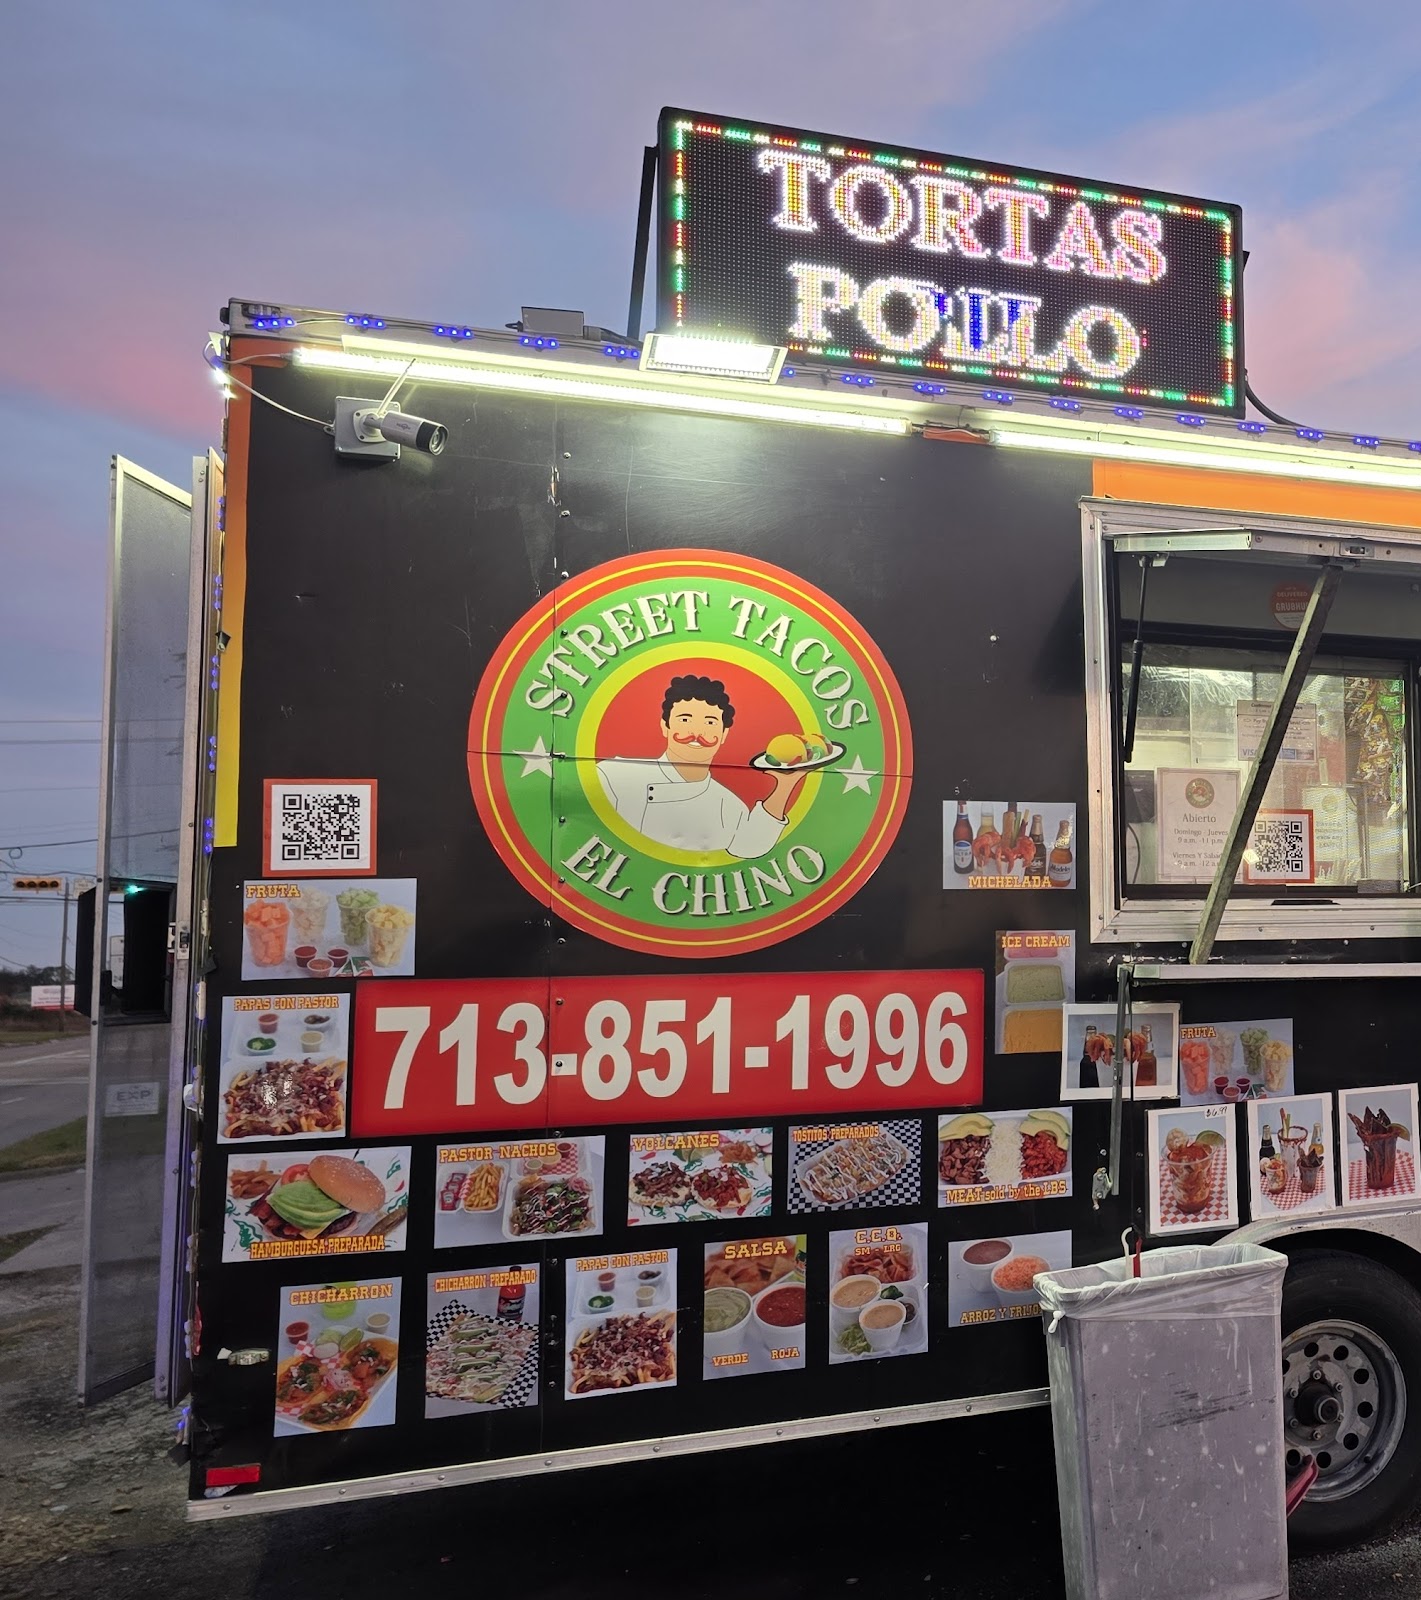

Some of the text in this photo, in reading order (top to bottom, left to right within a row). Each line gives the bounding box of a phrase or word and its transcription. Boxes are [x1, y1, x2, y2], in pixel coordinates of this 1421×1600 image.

[756, 147, 1167, 285] TORTAS
[1276, 602, 1308, 611] GRUBHU
[525, 590, 870, 730] STREET TACOS
[1183, 813, 1216, 822] Abierto
[560, 834, 826, 916] EL CHINO
[968, 876, 1052, 888] MICHELADA
[246, 885, 300, 898] FRUTA
[1002, 936, 1070, 948] ICE CREAM
[234, 996, 338, 1011] PAPAS CON PASTOR
[1181, 1027, 1216, 1039] FRUTA
[375, 991, 968, 1109] 713-851-1996
[633, 1134, 720, 1152] VOLCANES
[793, 1126, 880, 1142] TOSTITOS PREPARADOS
[946, 1180, 1067, 1204] MEAT sold by the LBS
[250, 1235, 385, 1259] HAMBURGUESA PREPARADA
[725, 1241, 787, 1260] SALSA
[855, 1248, 870, 1256] SM
[884, 1245, 901, 1253] LRG
[576, 1252, 668, 1272] PAPAS CON PASTOR
[435, 1270, 536, 1292] CHICHARRON PREPARADO
[290, 1284, 393, 1306] CHICHARRON
[961, 1304, 1041, 1324] ARROZ Y FRIJO
[713, 1354, 748, 1366] VERDE
[771, 1348, 800, 1360] ROJA
